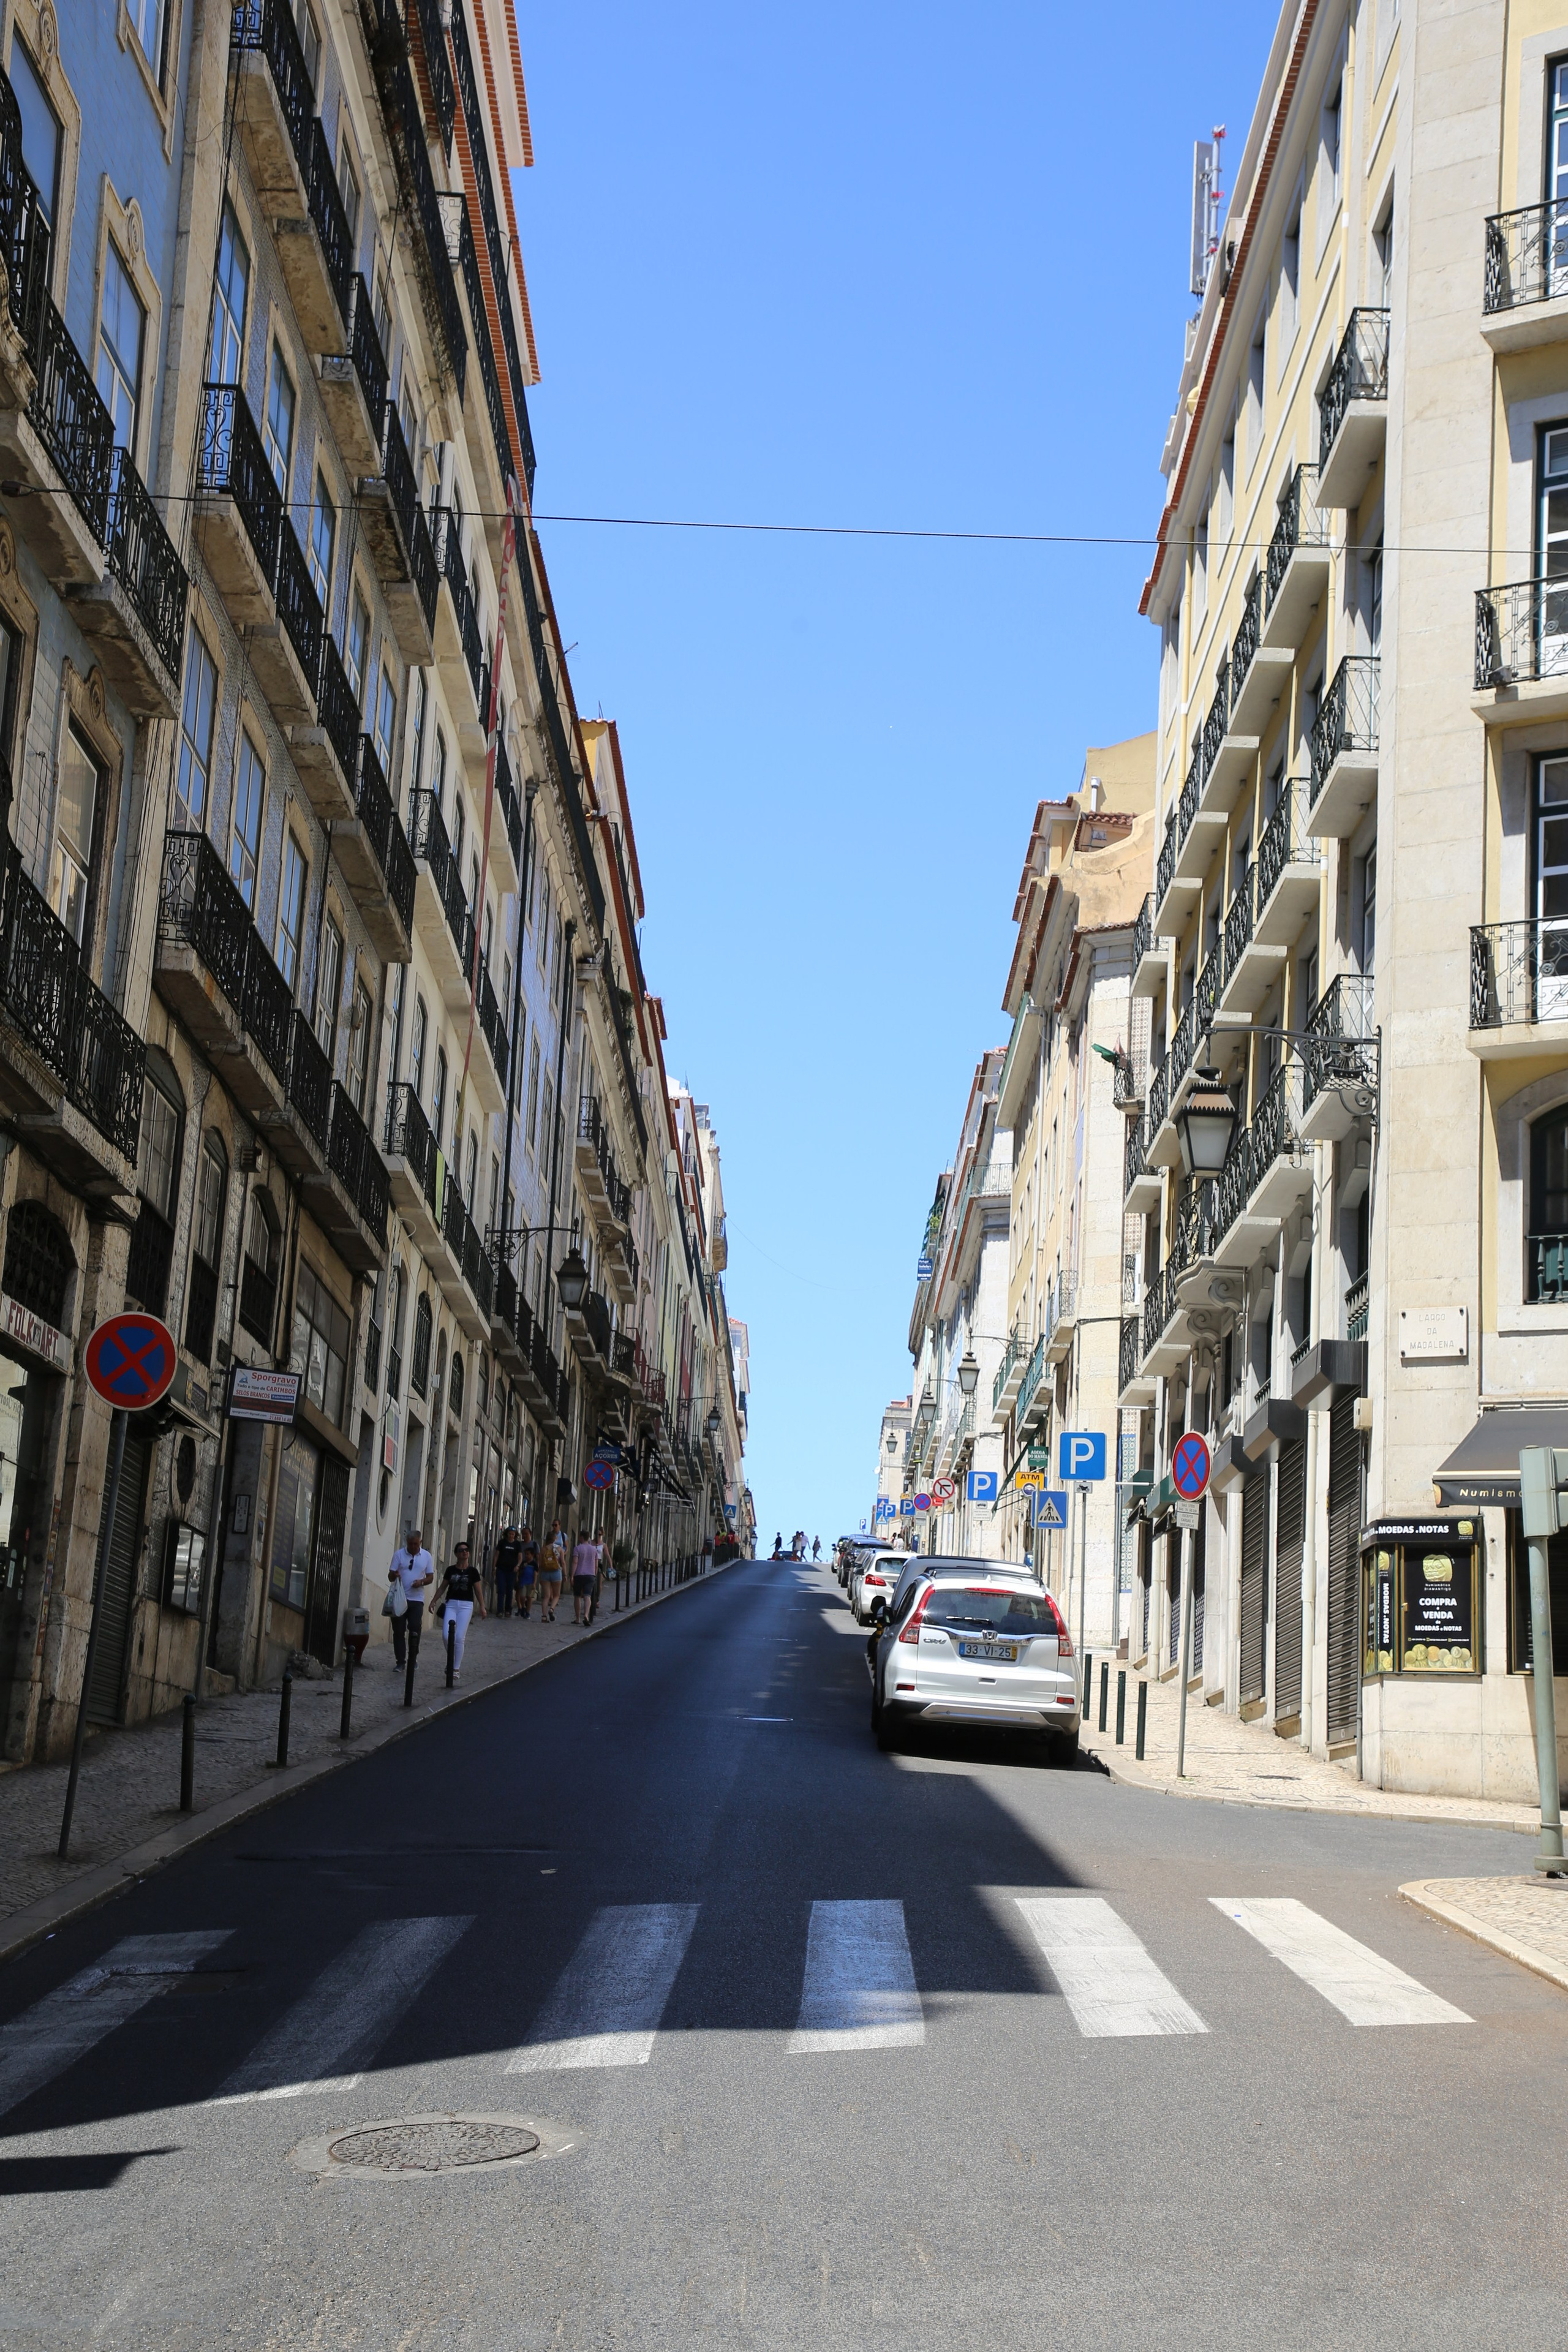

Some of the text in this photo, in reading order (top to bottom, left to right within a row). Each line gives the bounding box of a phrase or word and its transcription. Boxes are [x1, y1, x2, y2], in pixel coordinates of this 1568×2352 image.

[7, 1300, 59, 1361] FOLK ART
[1410, 1340, 1454, 1350] MADALENA
[251, 1372, 296, 1384] Sporgravo
[266, 1386, 296, 1395] CARIMBOS
[1070, 1438, 1095, 1474] P
[974, 1474, 991, 1498] P
[885, 1506, 894, 1516] P
[903, 1501, 913, 1514] P
[860, 1519, 865, 1528] P
[1419, 1598, 1457, 1606] COMPRA
